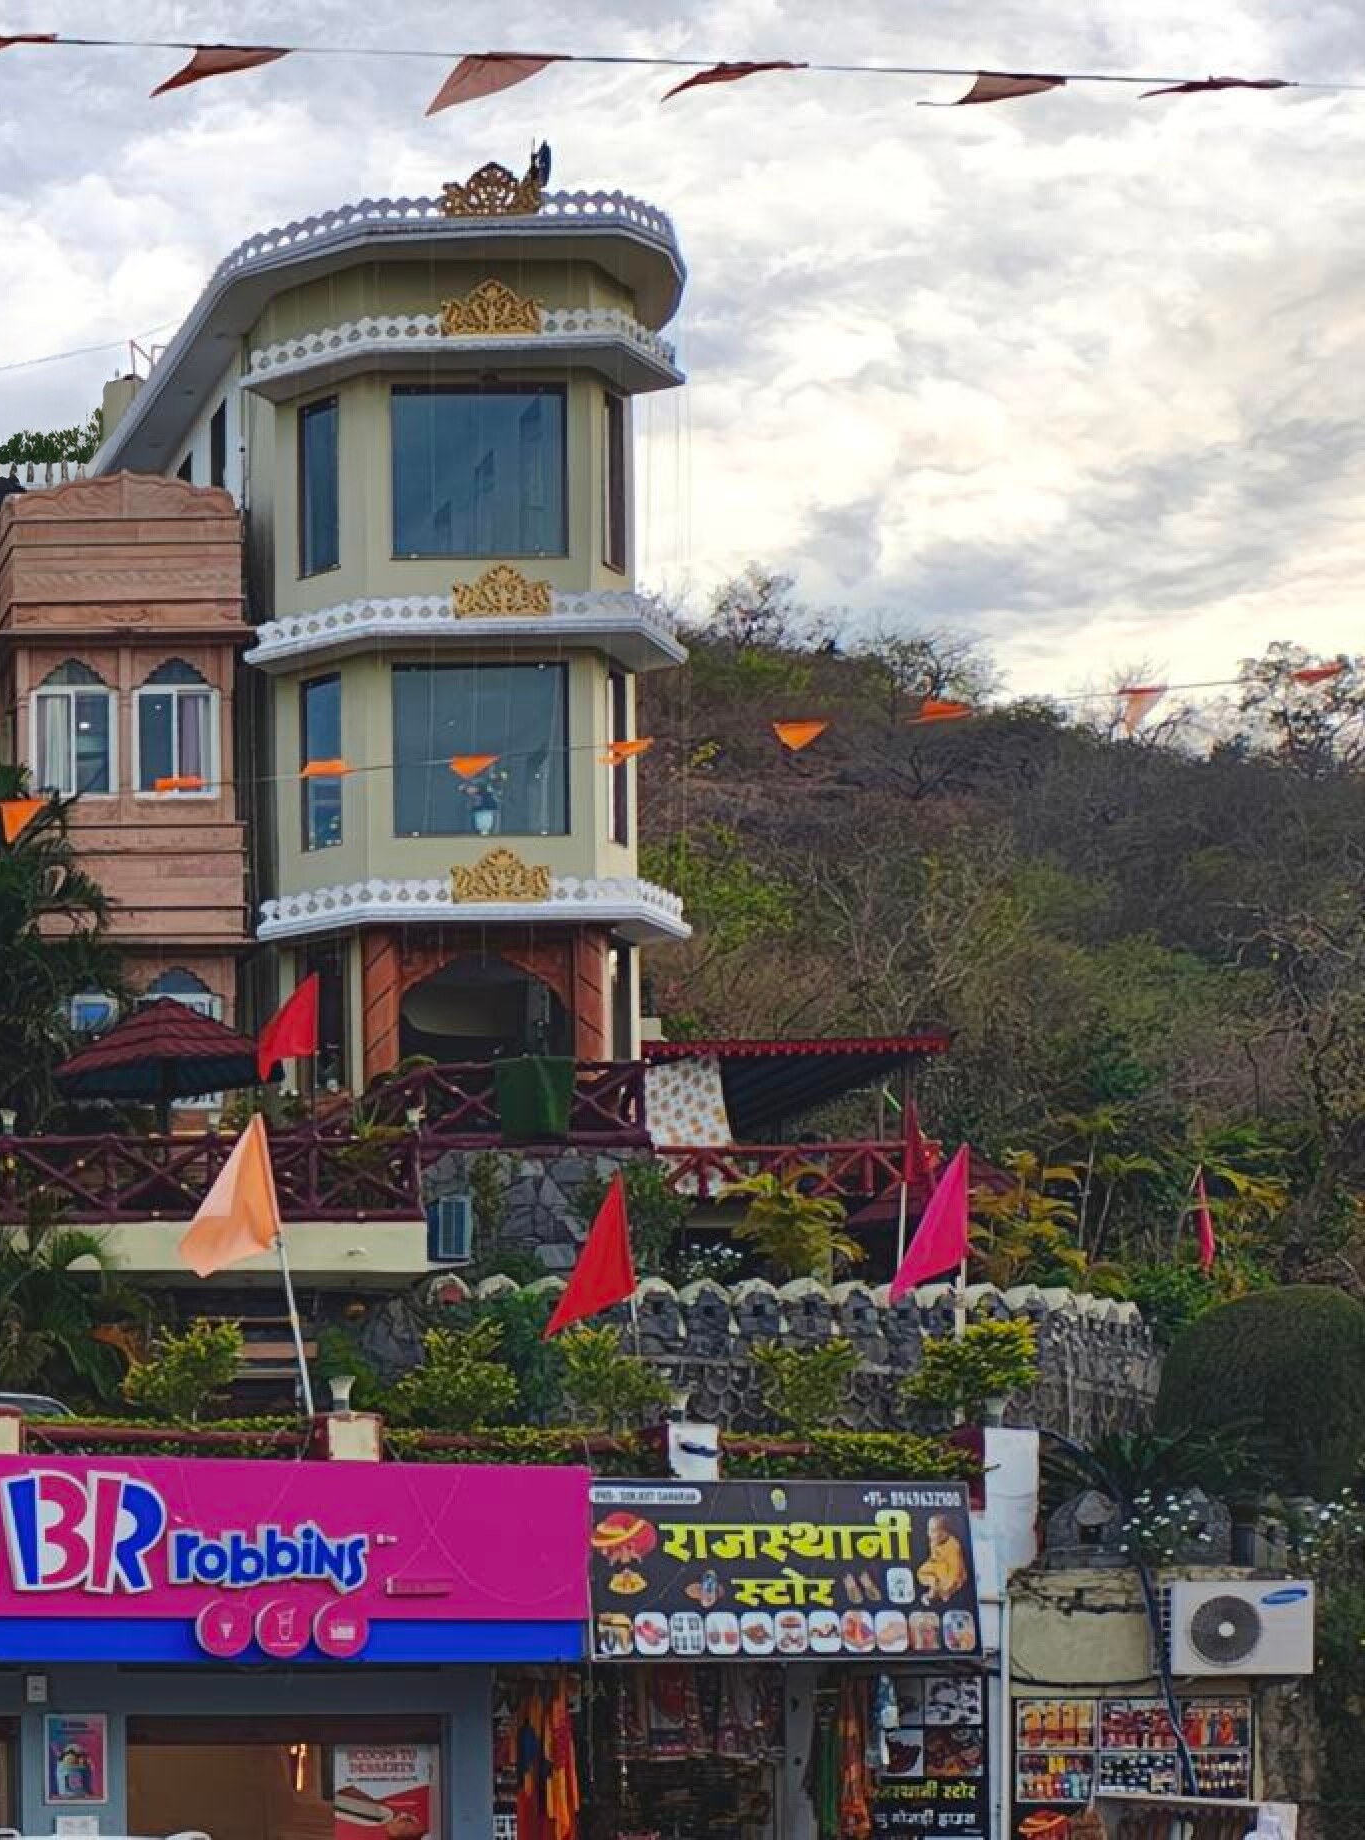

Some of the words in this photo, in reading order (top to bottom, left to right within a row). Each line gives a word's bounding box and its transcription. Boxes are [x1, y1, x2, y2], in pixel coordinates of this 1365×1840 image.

[169, 1522, 367, 1594] robbins
[658, 1509, 912, 1563] राजस्थानी
[730, 1567, 836, 1607] स्टोर
